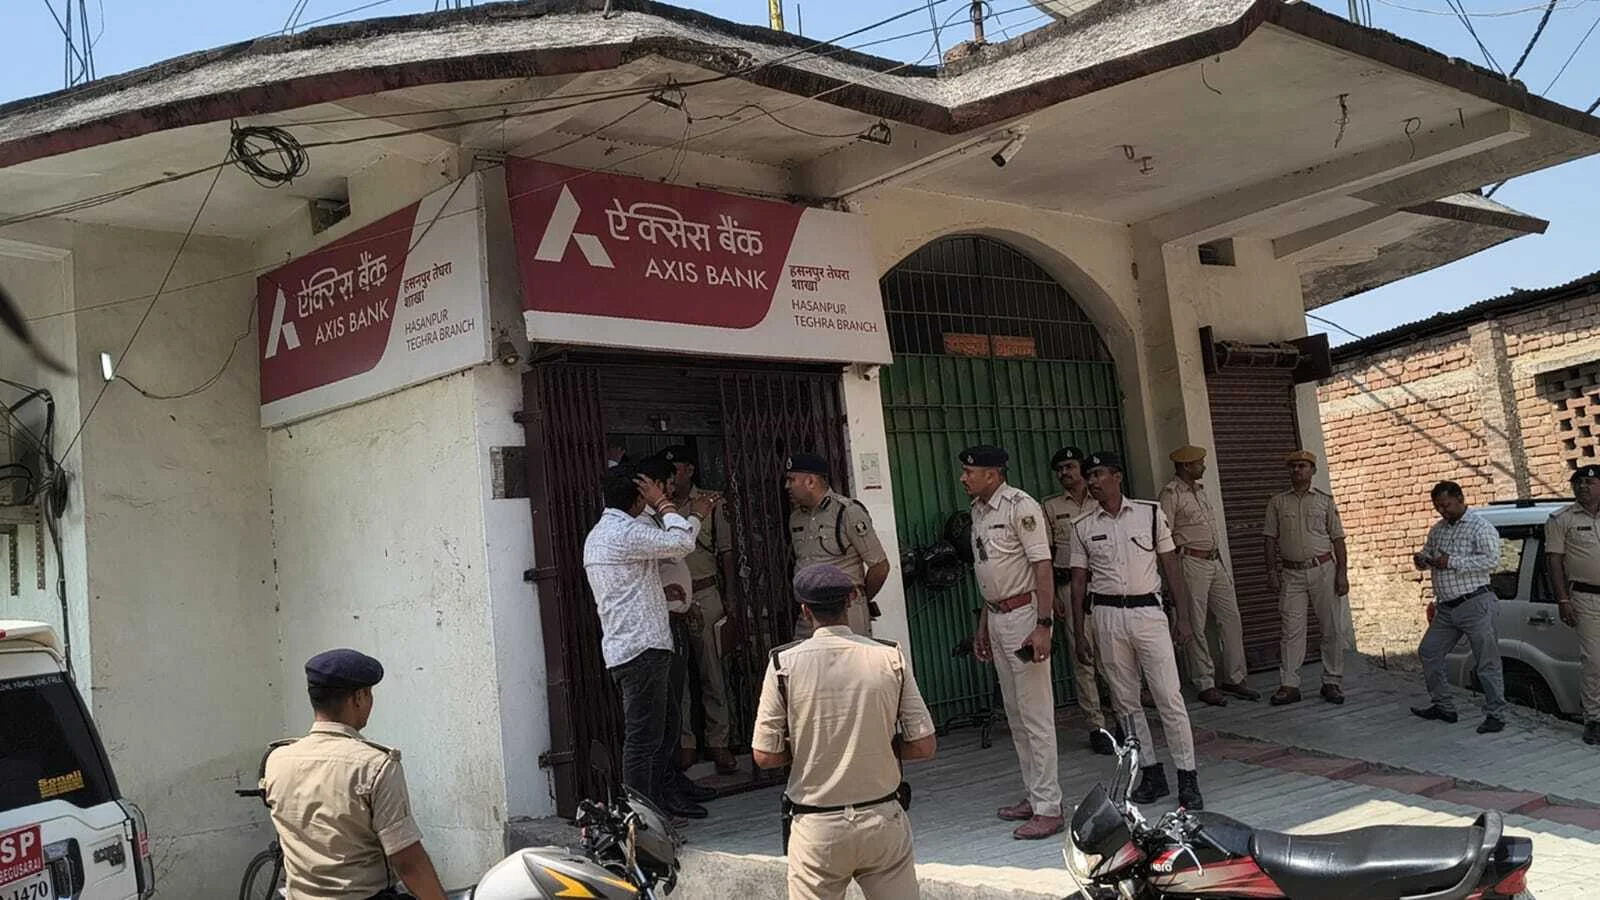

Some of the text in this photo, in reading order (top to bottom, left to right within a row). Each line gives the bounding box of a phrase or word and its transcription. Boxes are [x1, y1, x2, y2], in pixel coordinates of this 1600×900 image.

[716, 213, 764, 257] बैंक
[357, 250, 388, 292] बैंक
[403, 270, 431, 294] हसनपुर
[645, 257, 768, 290] AXIS BANK
[788, 265, 825, 281] हसनपुर
[791, 279, 818, 292] शाखा
[404, 290, 425, 308] शाखा
[791, 299, 847, 314] HASANPUR
[315, 298, 389, 345] AXIS BANK
[405, 308, 448, 335] HASANPUR
[794, 315, 878, 332] TEGHRA BRANCH
[406, 317, 475, 352] TEGHRA BRANCH
